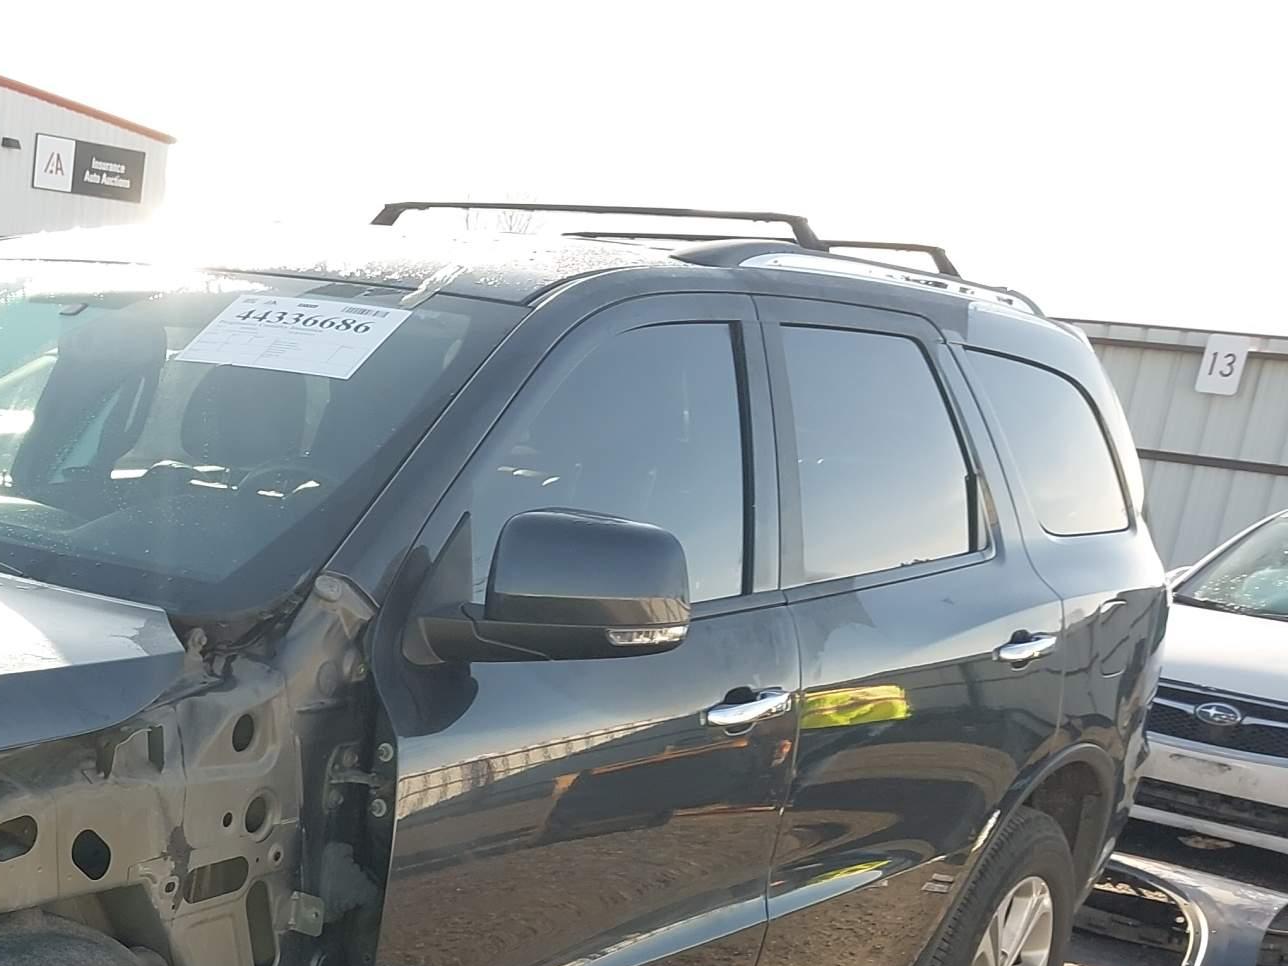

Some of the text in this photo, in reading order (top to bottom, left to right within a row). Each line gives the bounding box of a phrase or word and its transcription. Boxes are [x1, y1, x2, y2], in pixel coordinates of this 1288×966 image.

[92, 156, 126, 173] Insurance
[83, 169, 131, 188] Auto Auctions
[235, 308, 375, 334] 44336686
[1208, 352, 1237, 377] 13
